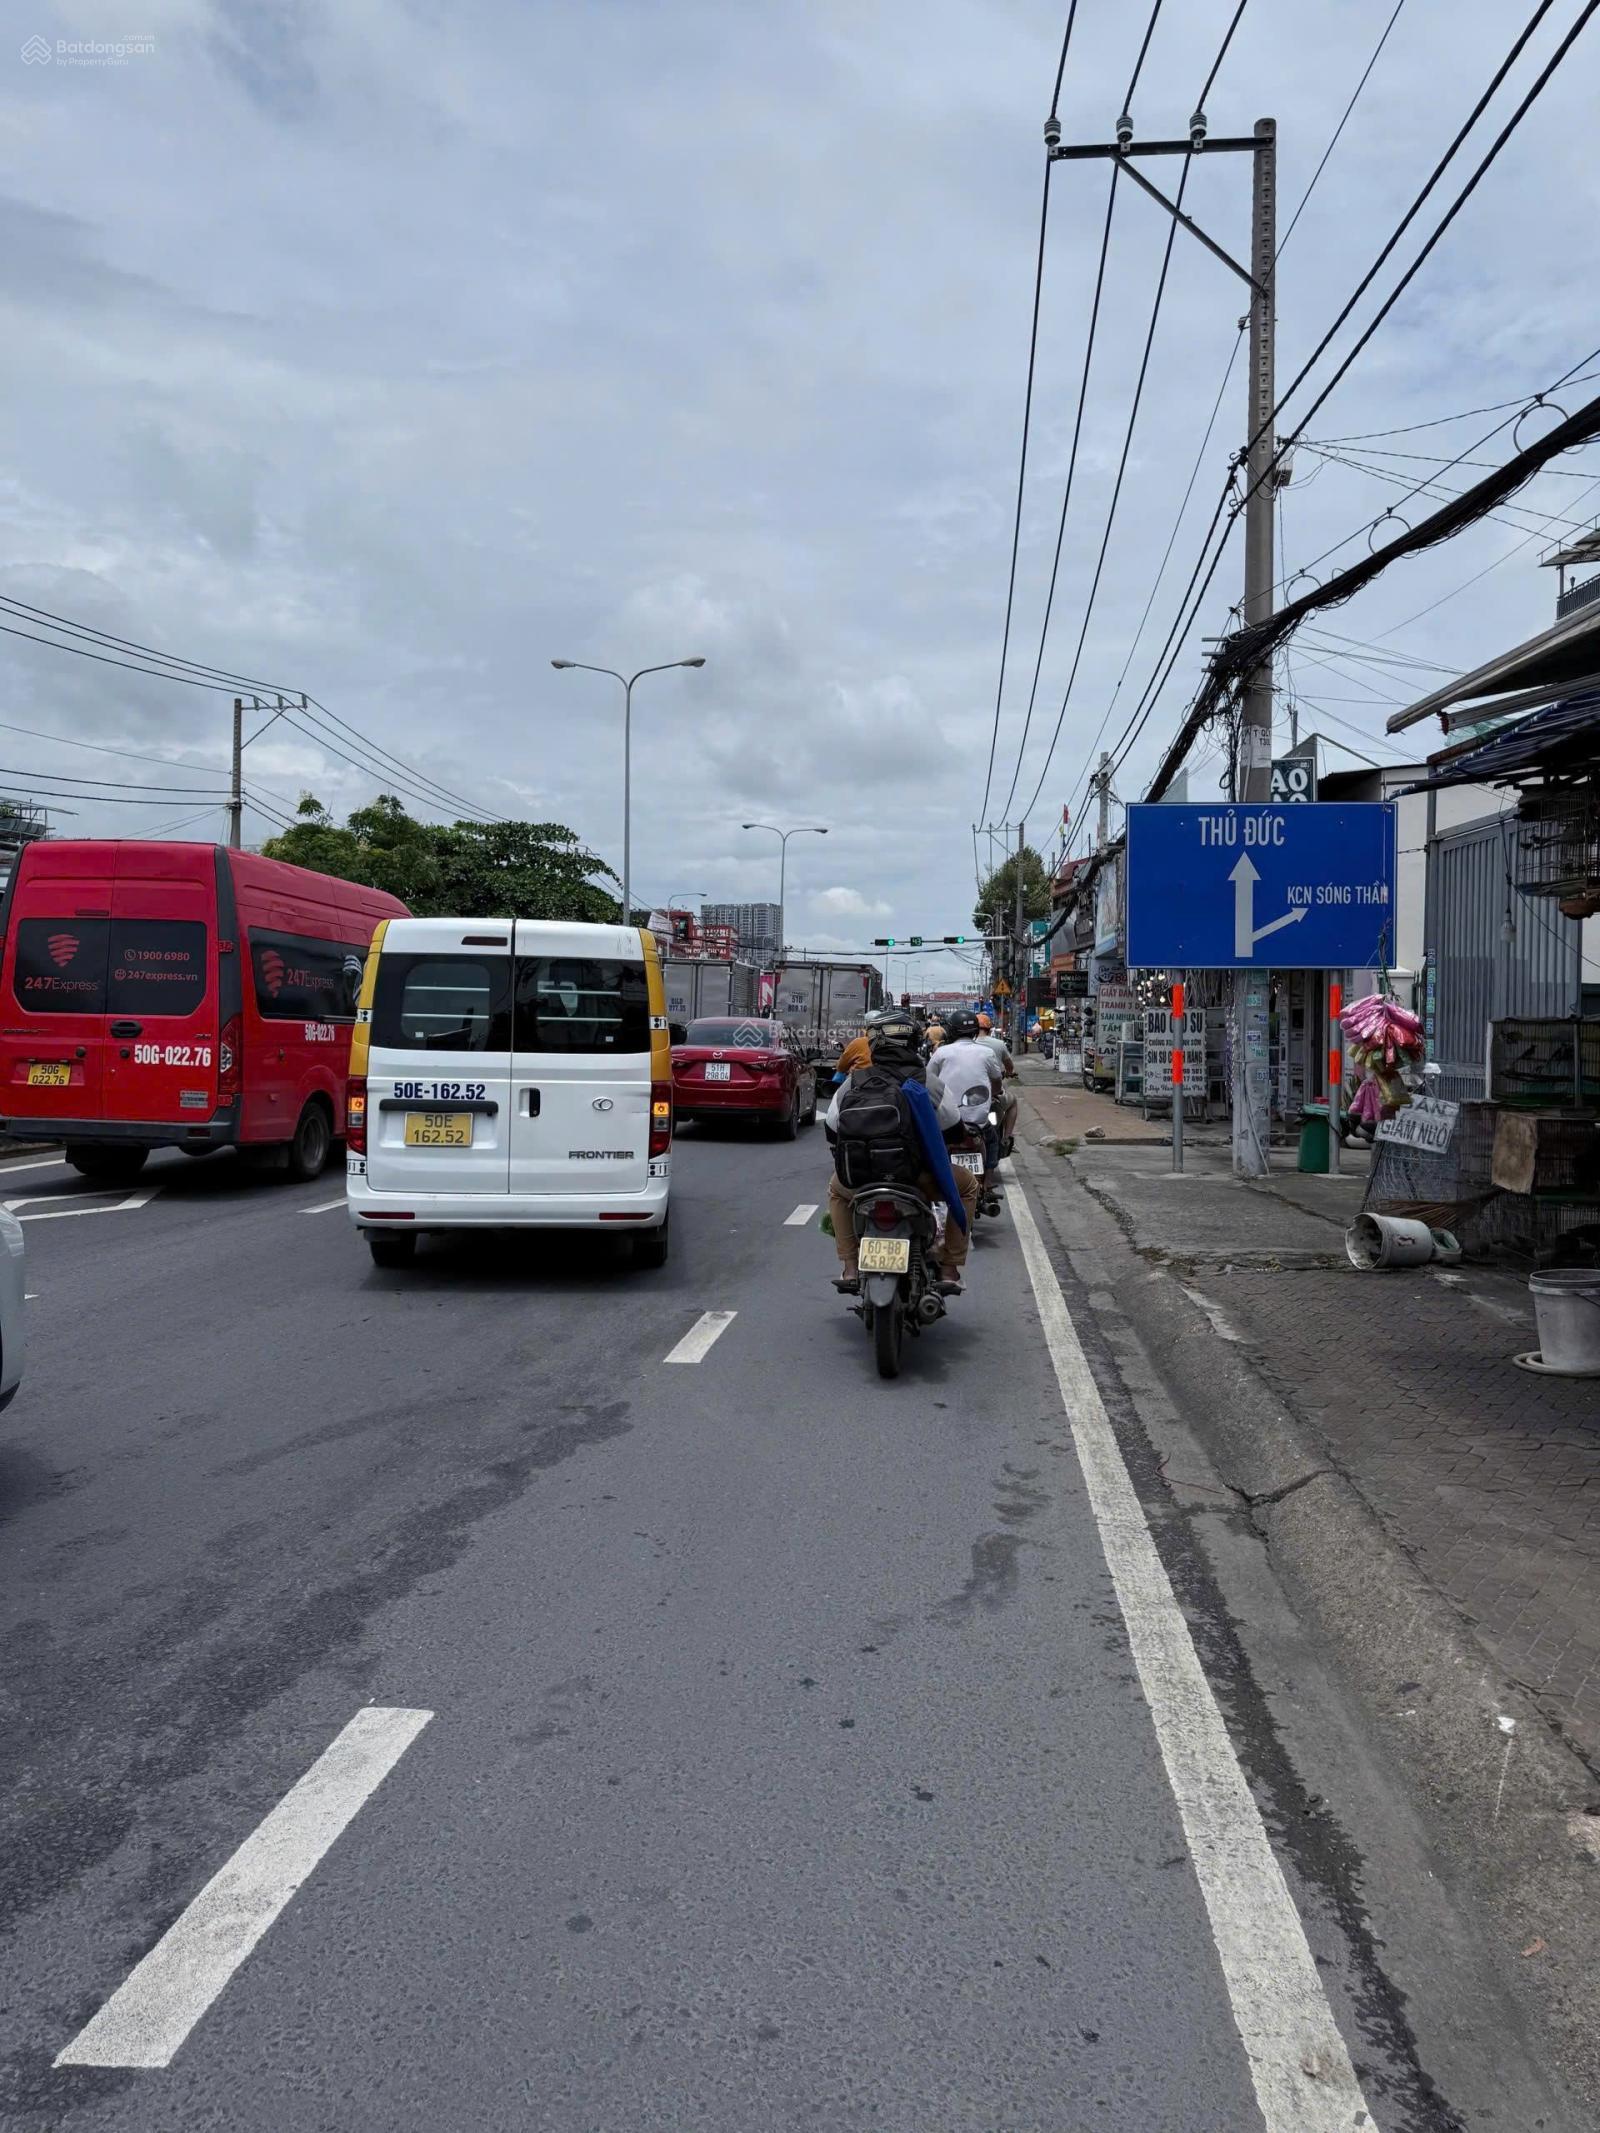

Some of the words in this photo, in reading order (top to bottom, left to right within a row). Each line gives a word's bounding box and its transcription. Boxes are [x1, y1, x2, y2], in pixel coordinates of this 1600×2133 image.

[1198, 809, 1237, 846] THỦ
[1243, 809, 1285, 846] ĐỨC
[1287, 886, 1312, 905] KCN
[1316, 882, 1351, 905] SÓNG
[1355, 880, 1388, 905] THẦN
[138, 951, 162, 961] 1900
[164, 952, 190, 961] 6980
[128, 971, 198, 982] 247express.vn
[287, 968, 334, 992] 247Express
[25, 977, 98, 992] 247Express
[1148, 1012, 1166, 1033] BAO
[1170, 1012, 1187, 1033] CO
[1191, 1012, 1203, 1033] SU
[305, 1024, 335, 1041] 50G-022.76
[134, 1045, 211, 1067] 50G-022.76
[41, 1065, 59, 1075] 50G
[711, 1062, 725, 1072] 51H
[32, 1075, 65, 1085] 022.76
[393, 1082, 486, 1101] 50E-162.52
[424, 1115, 453, 1129] 50E
[413, 1130, 465, 1144] 162.52
[568, 1150, 634, 1160] FRONTIER
[868, 1241, 902, 1255] 60-B8
